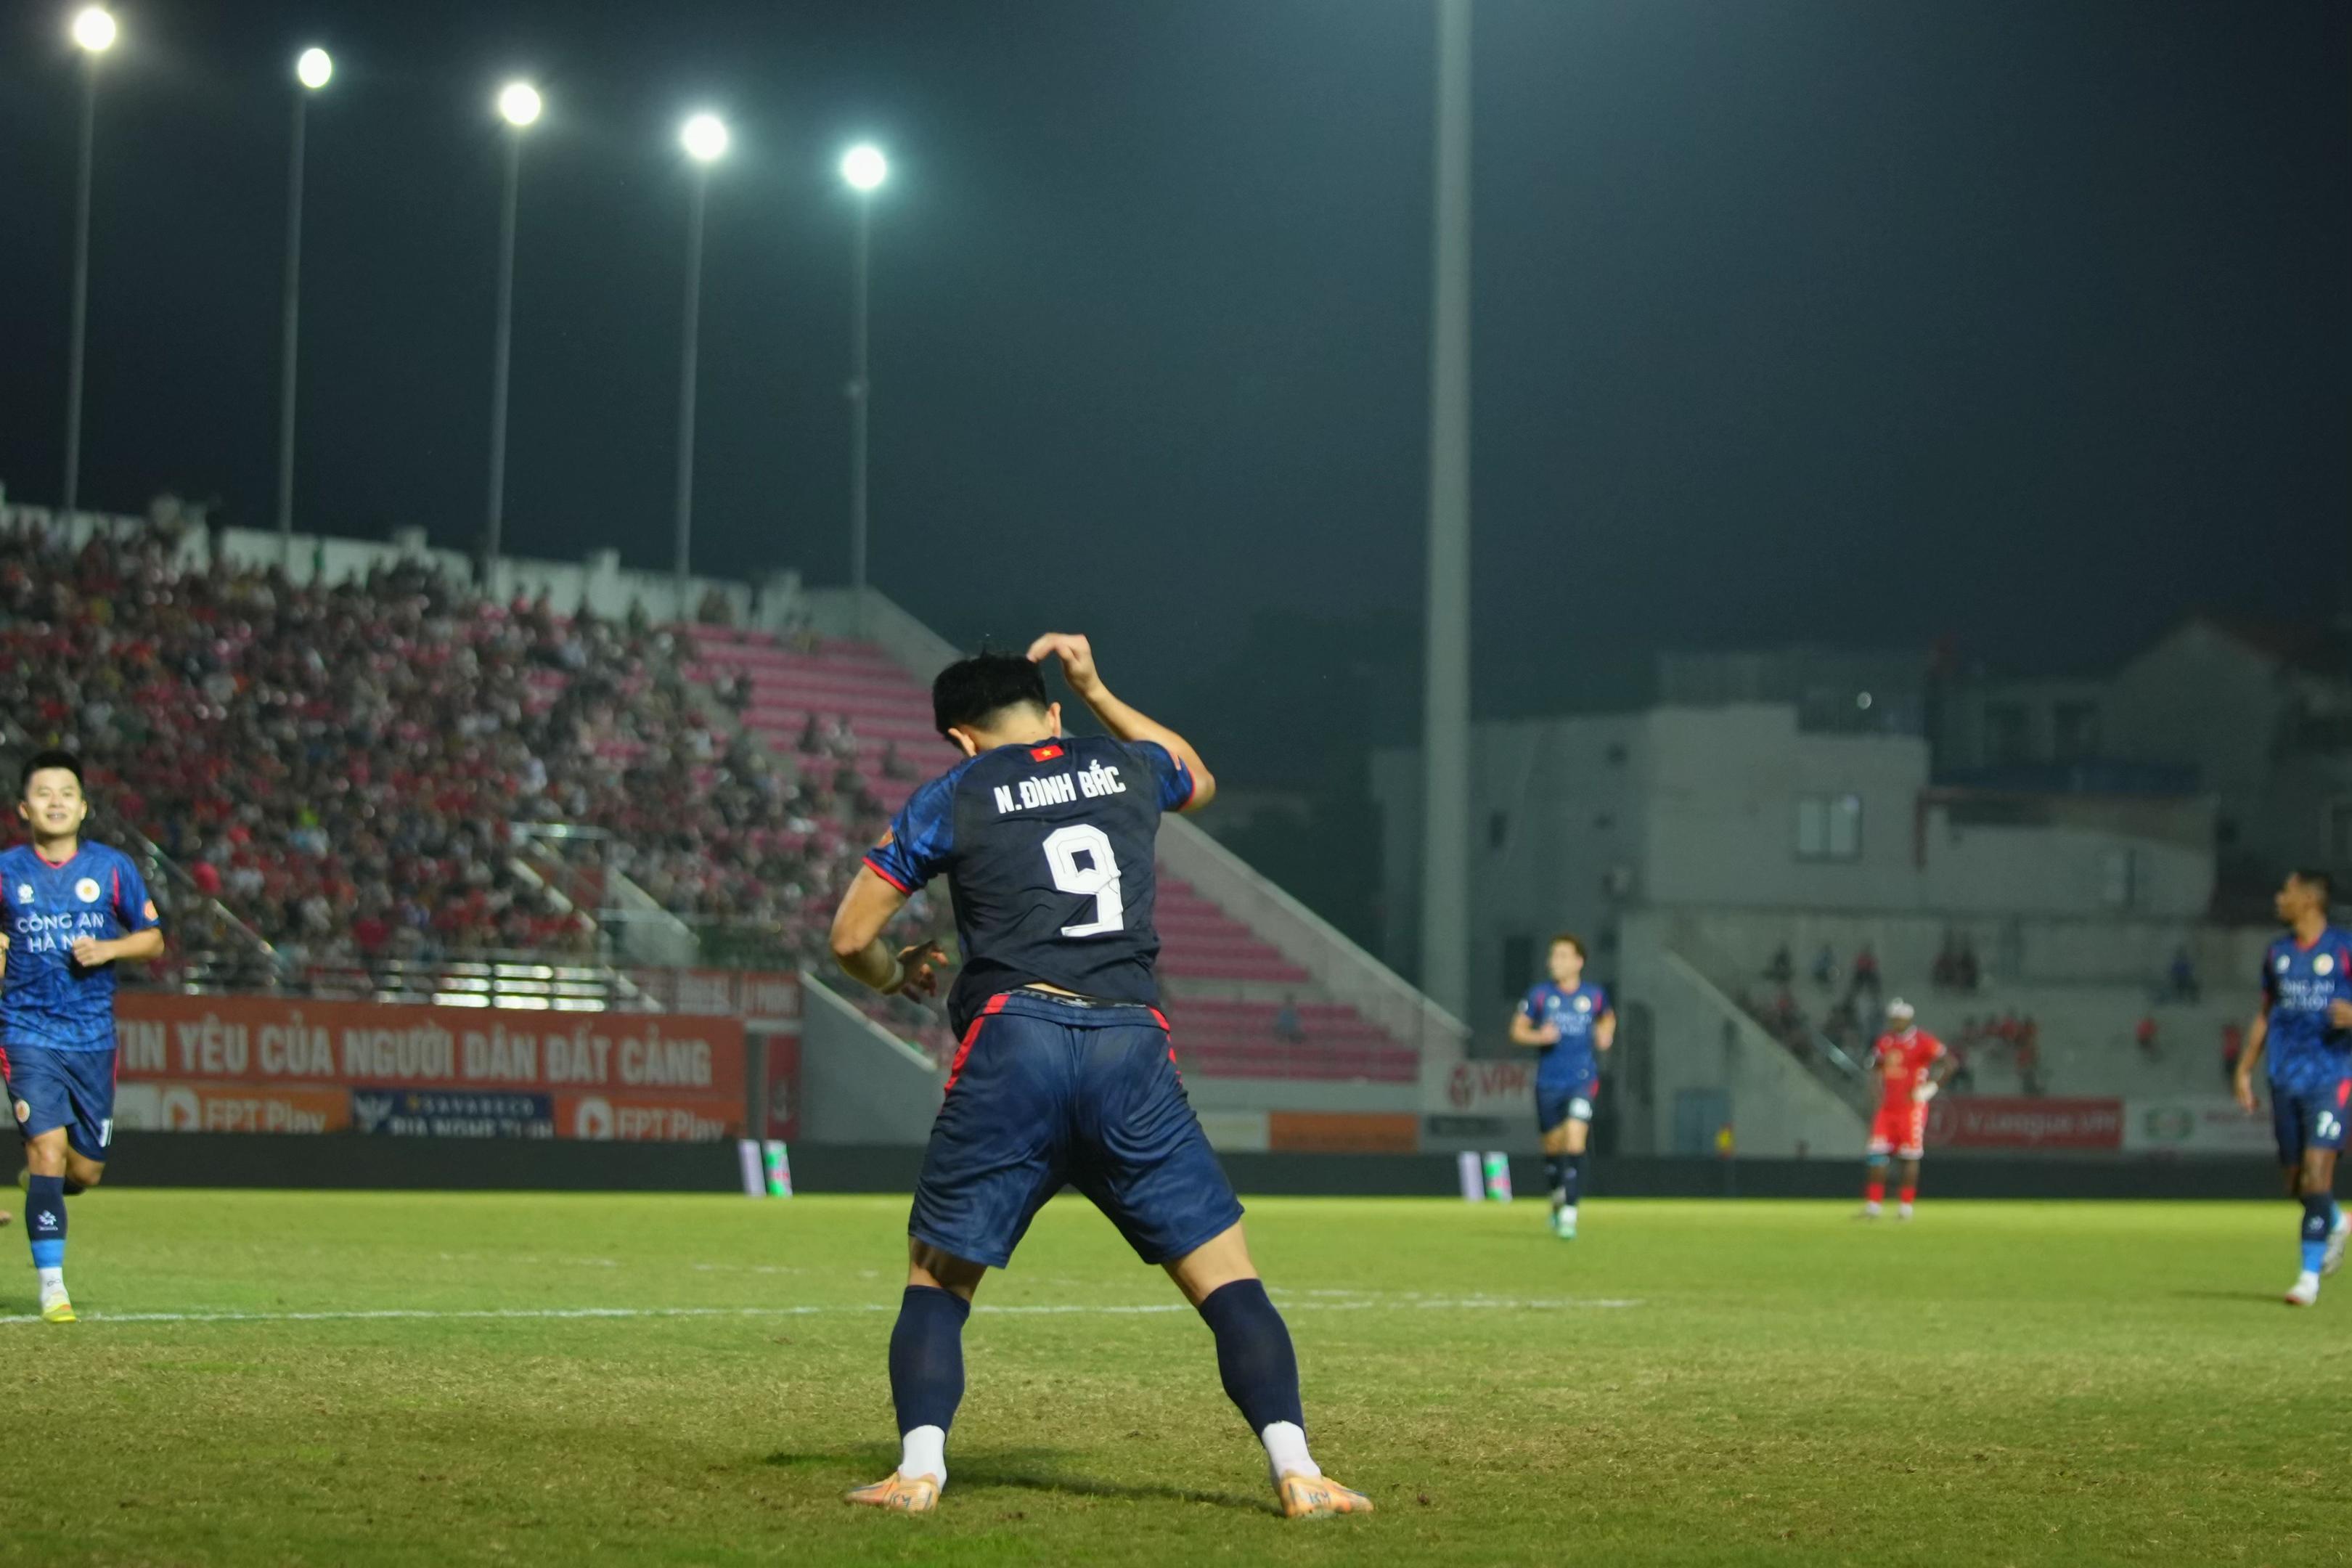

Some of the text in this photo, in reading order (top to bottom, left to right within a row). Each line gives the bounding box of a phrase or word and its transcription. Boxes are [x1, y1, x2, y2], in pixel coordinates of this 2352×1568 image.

[993, 759, 1127, 814] N.ĐÌNH BẮC
[1042, 824, 1124, 937] 9
[16, 912, 104, 933] CÔNG AN
[27, 929, 57, 952] HÀ
[176, 1011, 248, 1075] YÊU
[259, 1009, 335, 1077] CỦA
[343, 1017, 455, 1079] NGƯỜI
[463, 1021, 537, 1081] DÂN
[620, 1022, 712, 1087] CẢNG
[206, 1098, 259, 1132] FPT
[618, 1106, 669, 1140] FPT
